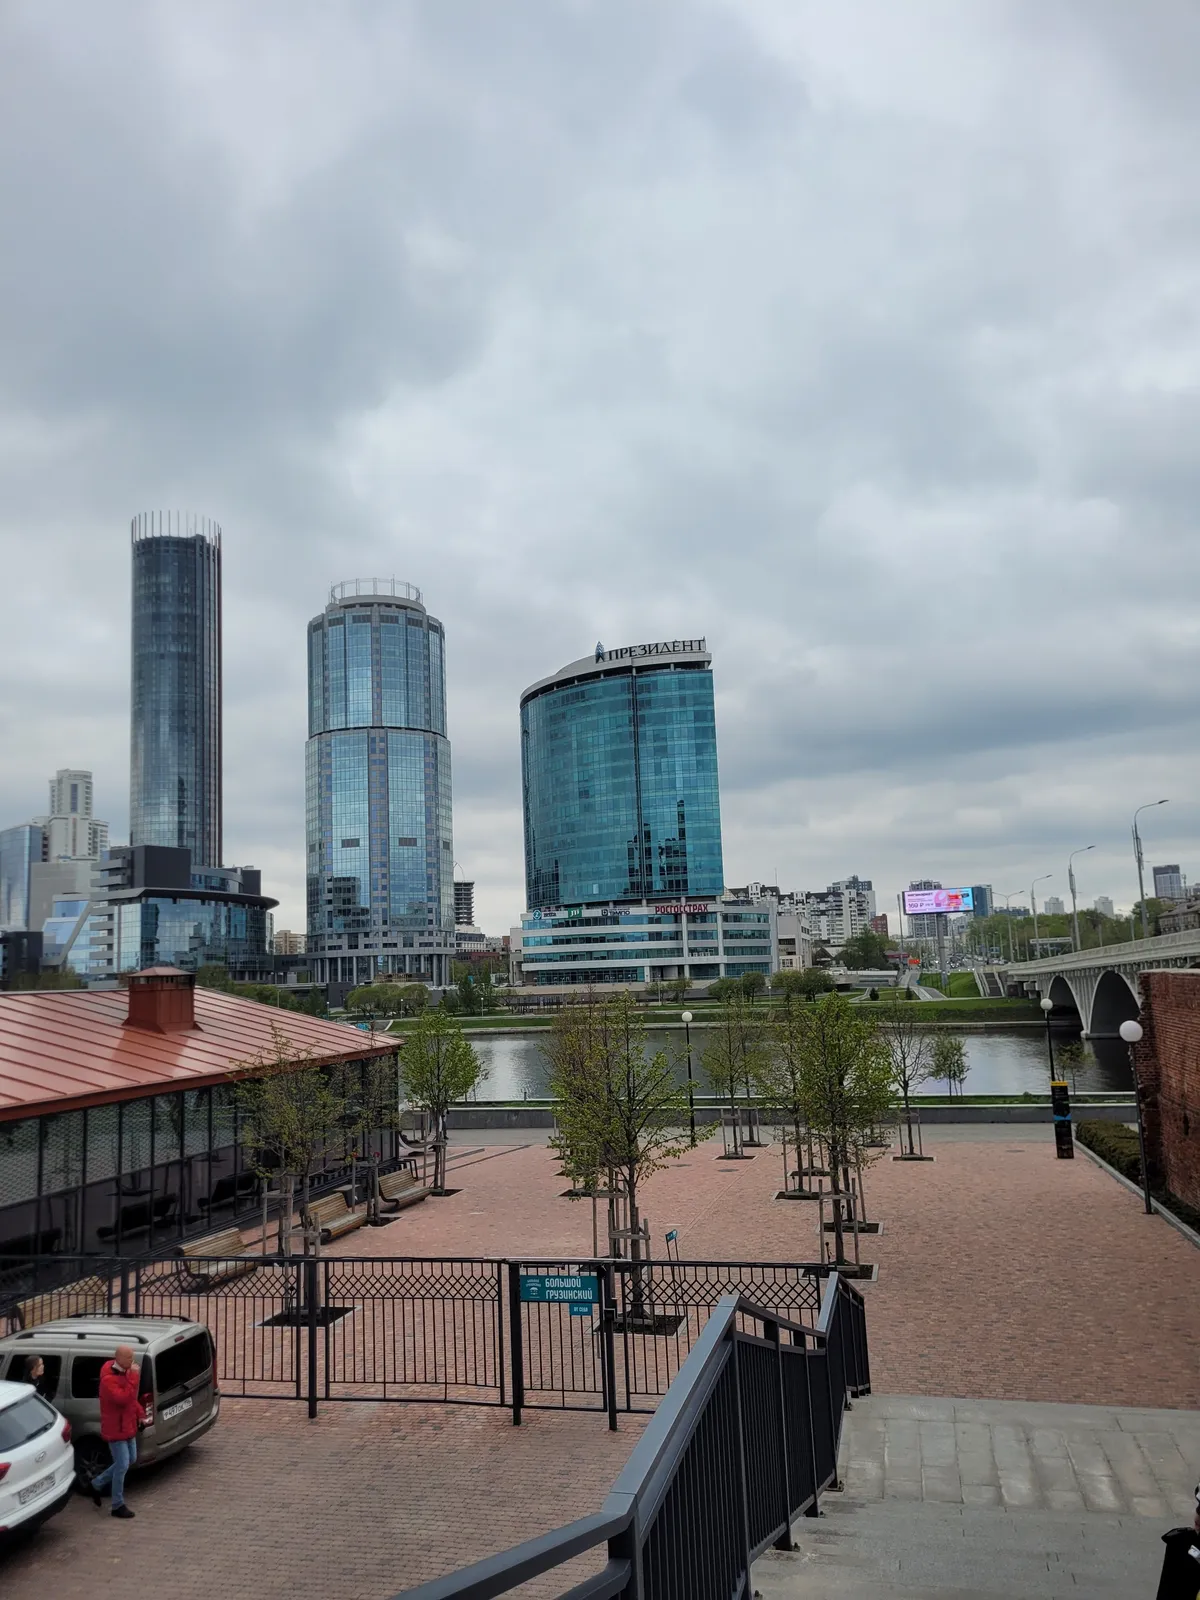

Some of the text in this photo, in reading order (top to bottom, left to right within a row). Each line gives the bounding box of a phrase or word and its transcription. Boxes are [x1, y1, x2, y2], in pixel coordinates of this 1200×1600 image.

[608, 640, 705, 660] ПРЕЗИДЕНТ
[655, 904, 708, 914] РОСГОССТРАХ
[545, 1276, 582, 1288] БОЛЬШОЙ
[545, 1288, 593, 1300] ГРУЗИНСКИЙ
